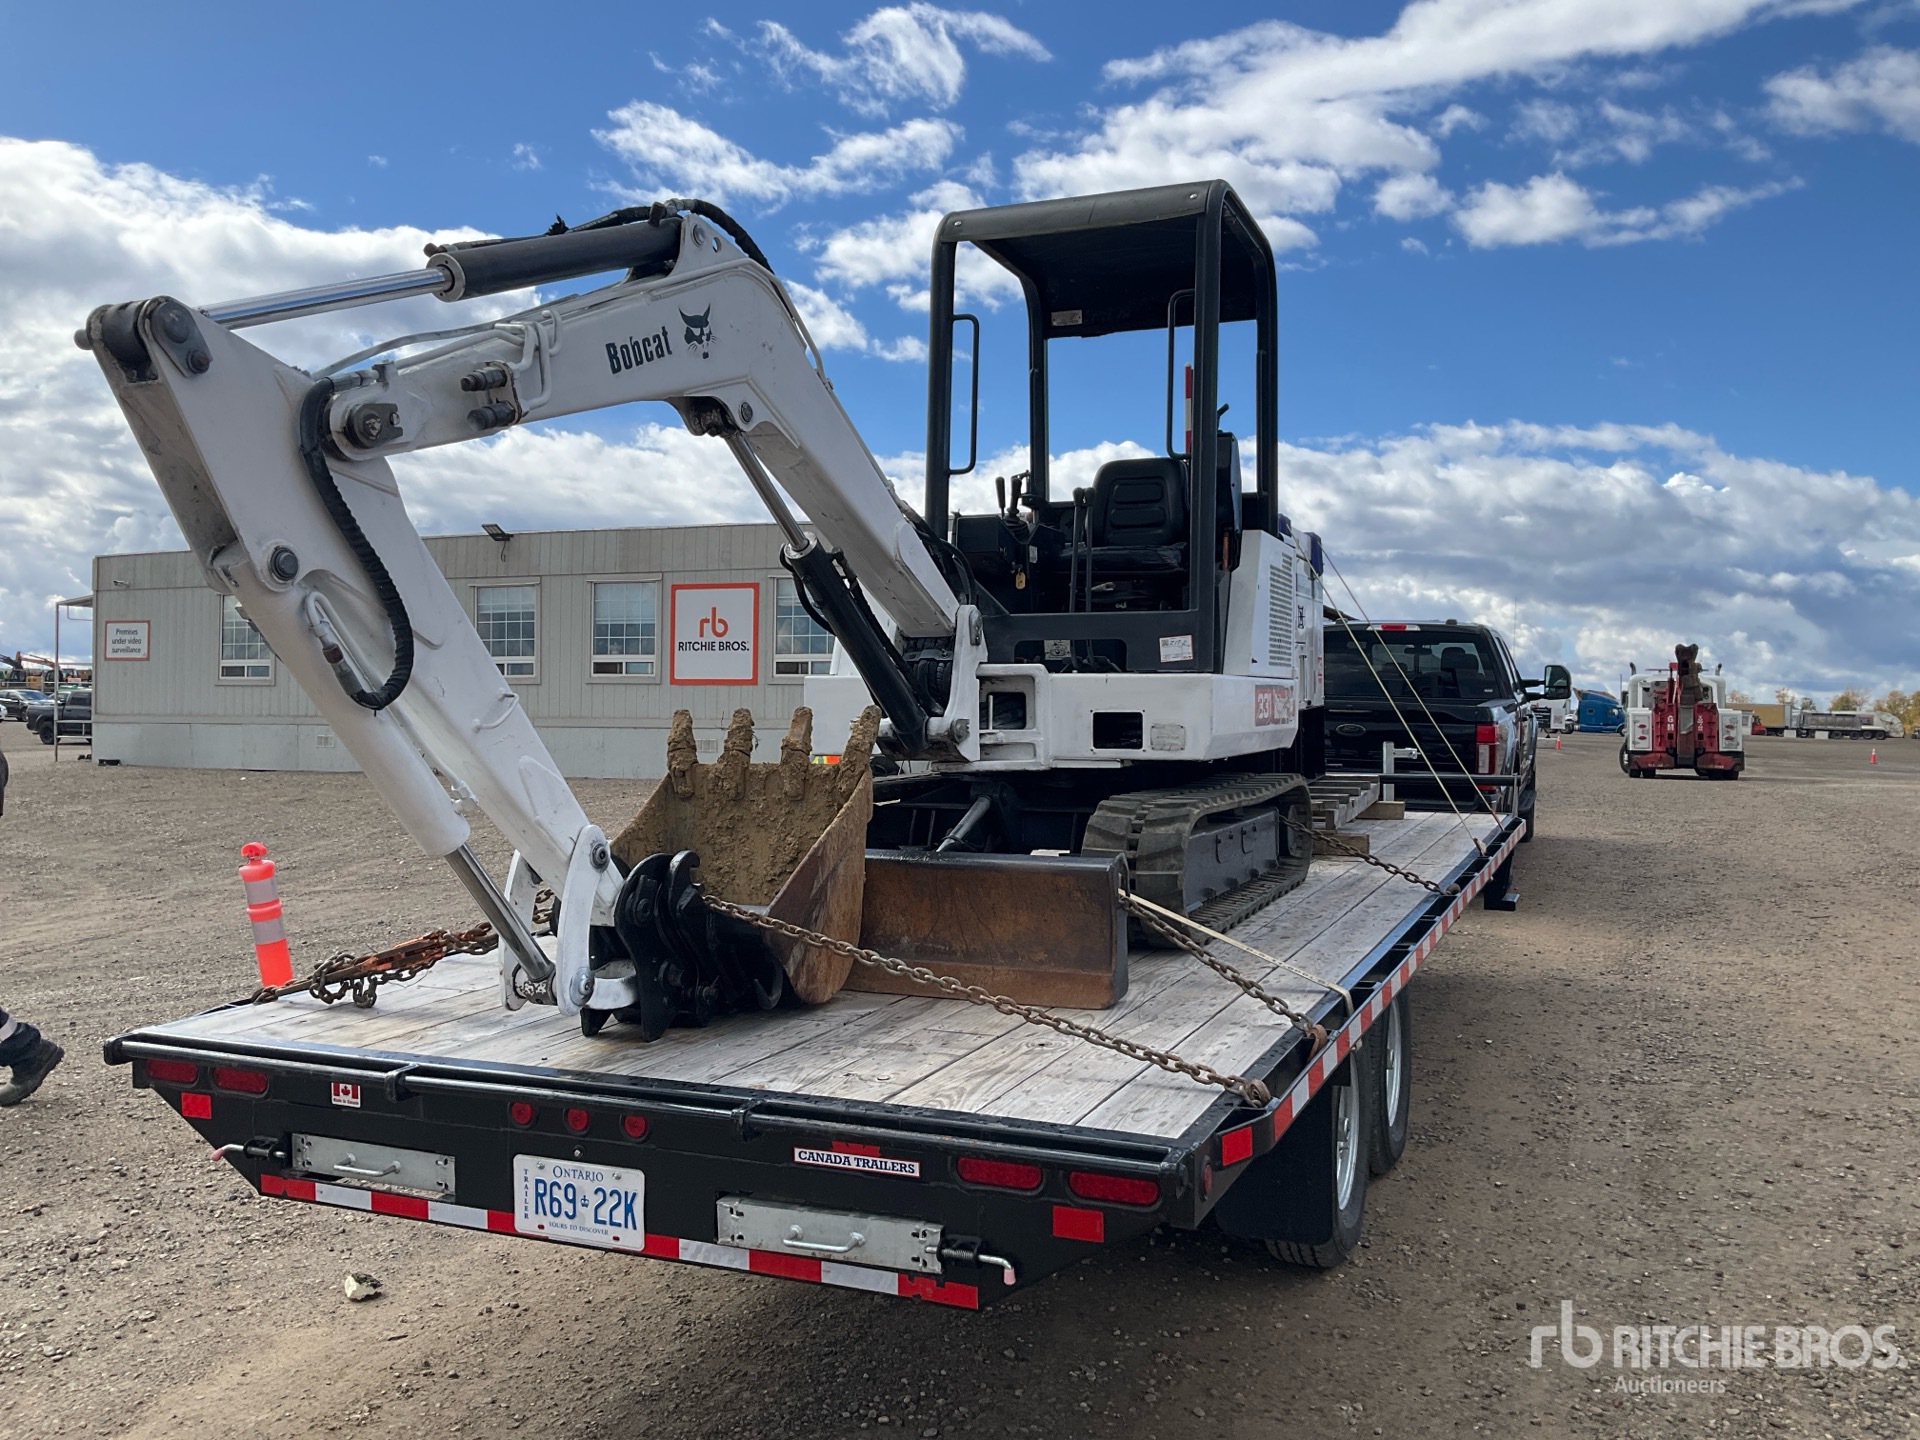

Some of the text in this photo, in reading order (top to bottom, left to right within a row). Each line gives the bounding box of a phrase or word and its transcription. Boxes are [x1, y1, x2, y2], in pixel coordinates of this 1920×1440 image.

[606, 326, 672, 374] Bobcat
[699, 607, 728, 637] rb
[678, 641, 750, 651] RITCHIE BROS.
[798, 1150, 915, 1174] CANADA TRAILERS
[534, 1177, 637, 1230] R69 22K
[548, 1221, 609, 1235] YOURS TO DISCOVER
